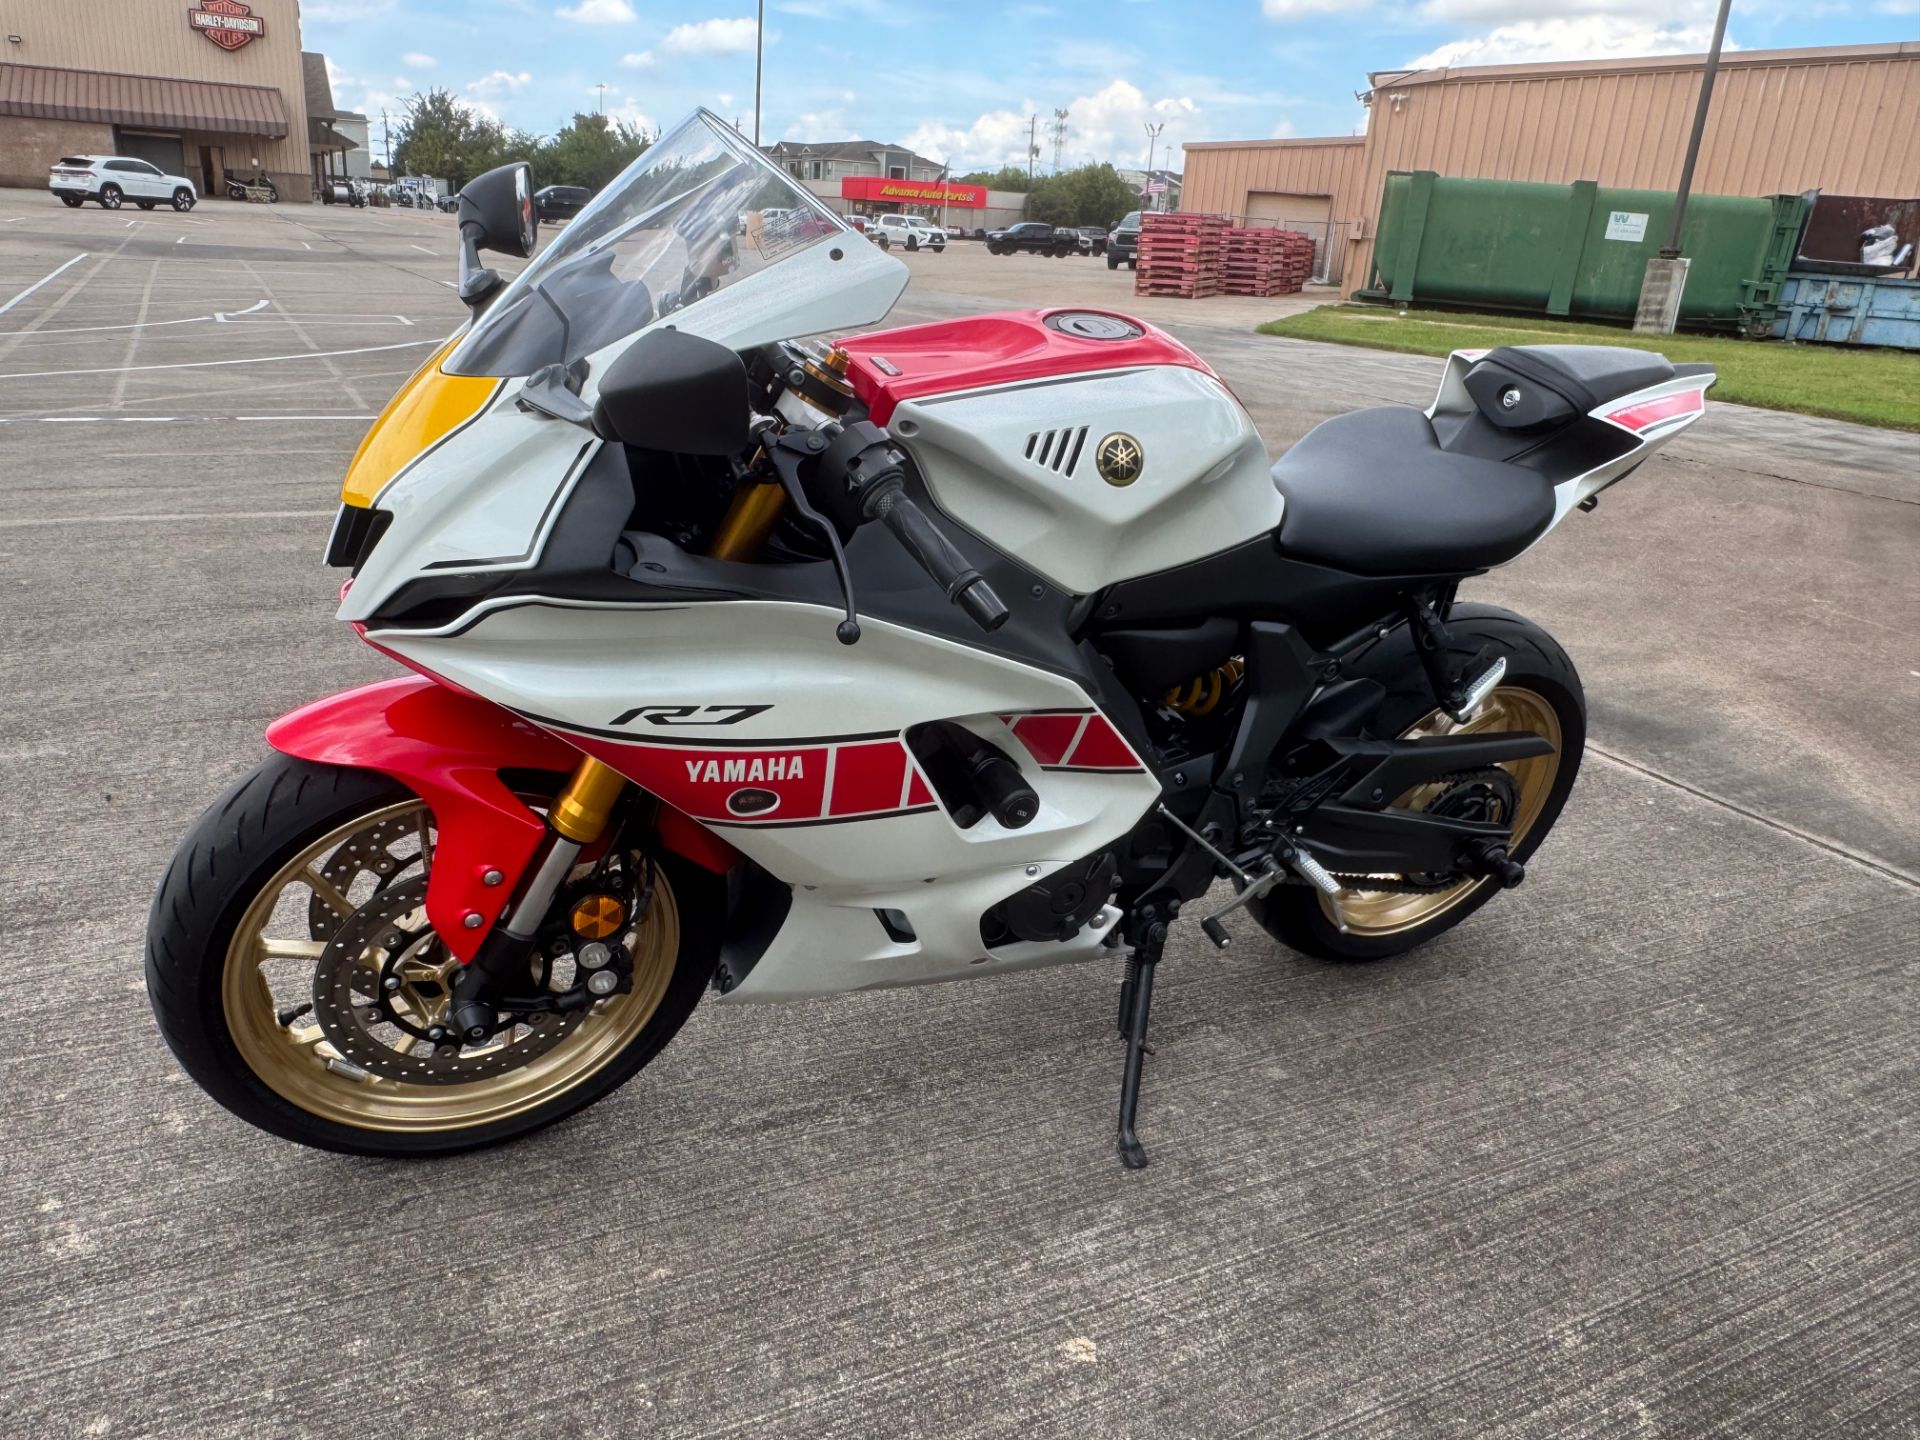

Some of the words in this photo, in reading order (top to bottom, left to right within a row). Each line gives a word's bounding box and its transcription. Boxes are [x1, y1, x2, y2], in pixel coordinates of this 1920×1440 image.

[208, 3, 243, 15] MOTOR
[194, 13, 259, 32] HARLEY-DAVIDSON
[208, 29, 245, 45] CYCLES
[880, 185, 919, 197] Advance
[919, 188, 943, 200] Auto
[943, 190, 967, 201] Parts
[608, 704, 776, 726] R7
[685, 755, 804, 783] YAMAHA
